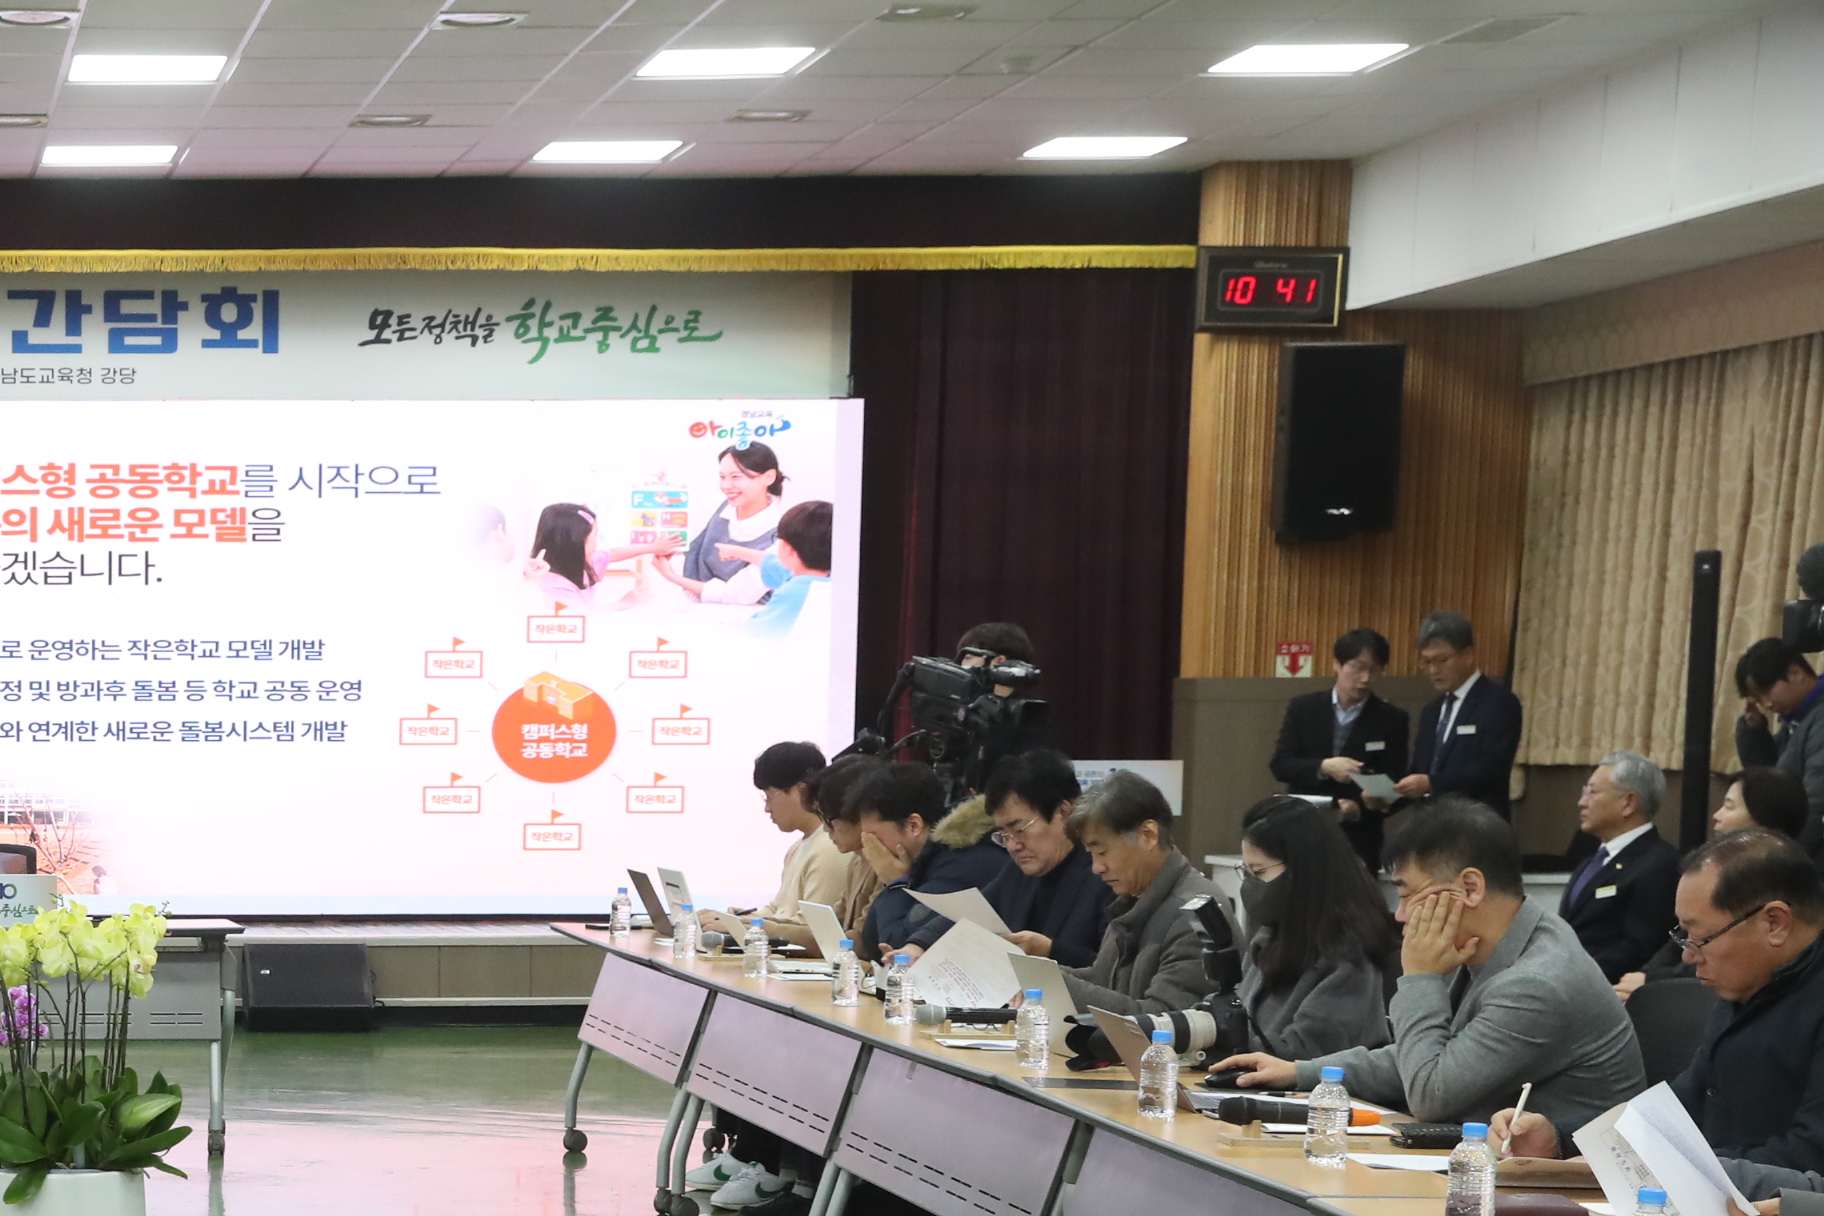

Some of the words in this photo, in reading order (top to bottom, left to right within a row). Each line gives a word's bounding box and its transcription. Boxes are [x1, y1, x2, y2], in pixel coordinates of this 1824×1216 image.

[1225, 276, 1257, 305] 10
[1275, 278, 1318, 303] 41
[505, 297, 724, 364] 학교중심으로
[100, 367, 137, 385] 강당
[689, 419, 792, 450] 아이좋아
[85, 462, 279, 499] 공동학교를
[288, 463, 441, 499] 시작으로
[46, 506, 164, 543] 새로운
[169, 506, 286, 543] 모델을
[535, 624, 578, 634] 작은학교
[27, 638, 123, 662] 운영하는
[127, 638, 222, 661] 작은학교
[225, 638, 273, 661] 모델
[278, 638, 326, 661] 개발
[433, 660, 475, 670] 작은학교
[637, 660, 680, 670] 작은학교
[28, 679, 51, 702] 및
[56, 679, 127, 702] 방과후
[131, 680, 180, 702] 돌봄
[183, 679, 208, 702] 등
[212, 679, 260, 702] 학교
[263, 680, 312, 702] 공동
[315, 679, 362, 702] 운영
[27, 720, 99, 743] 연계한
[102, 720, 175, 743] 새로운
[178, 720, 295, 743] 돌봄시스템
[300, 720, 349, 743] 개발
[407, 726, 451, 737] 작은학교
[521, 723, 588, 740] 캠퍼스형
[660, 726, 703, 737] 작은학교
[521, 742, 588, 759] 공동학교
[431, 794, 473, 805] 작은학교
[634, 794, 677, 805] 작은학교
[531, 831, 574, 842] 작은학교
